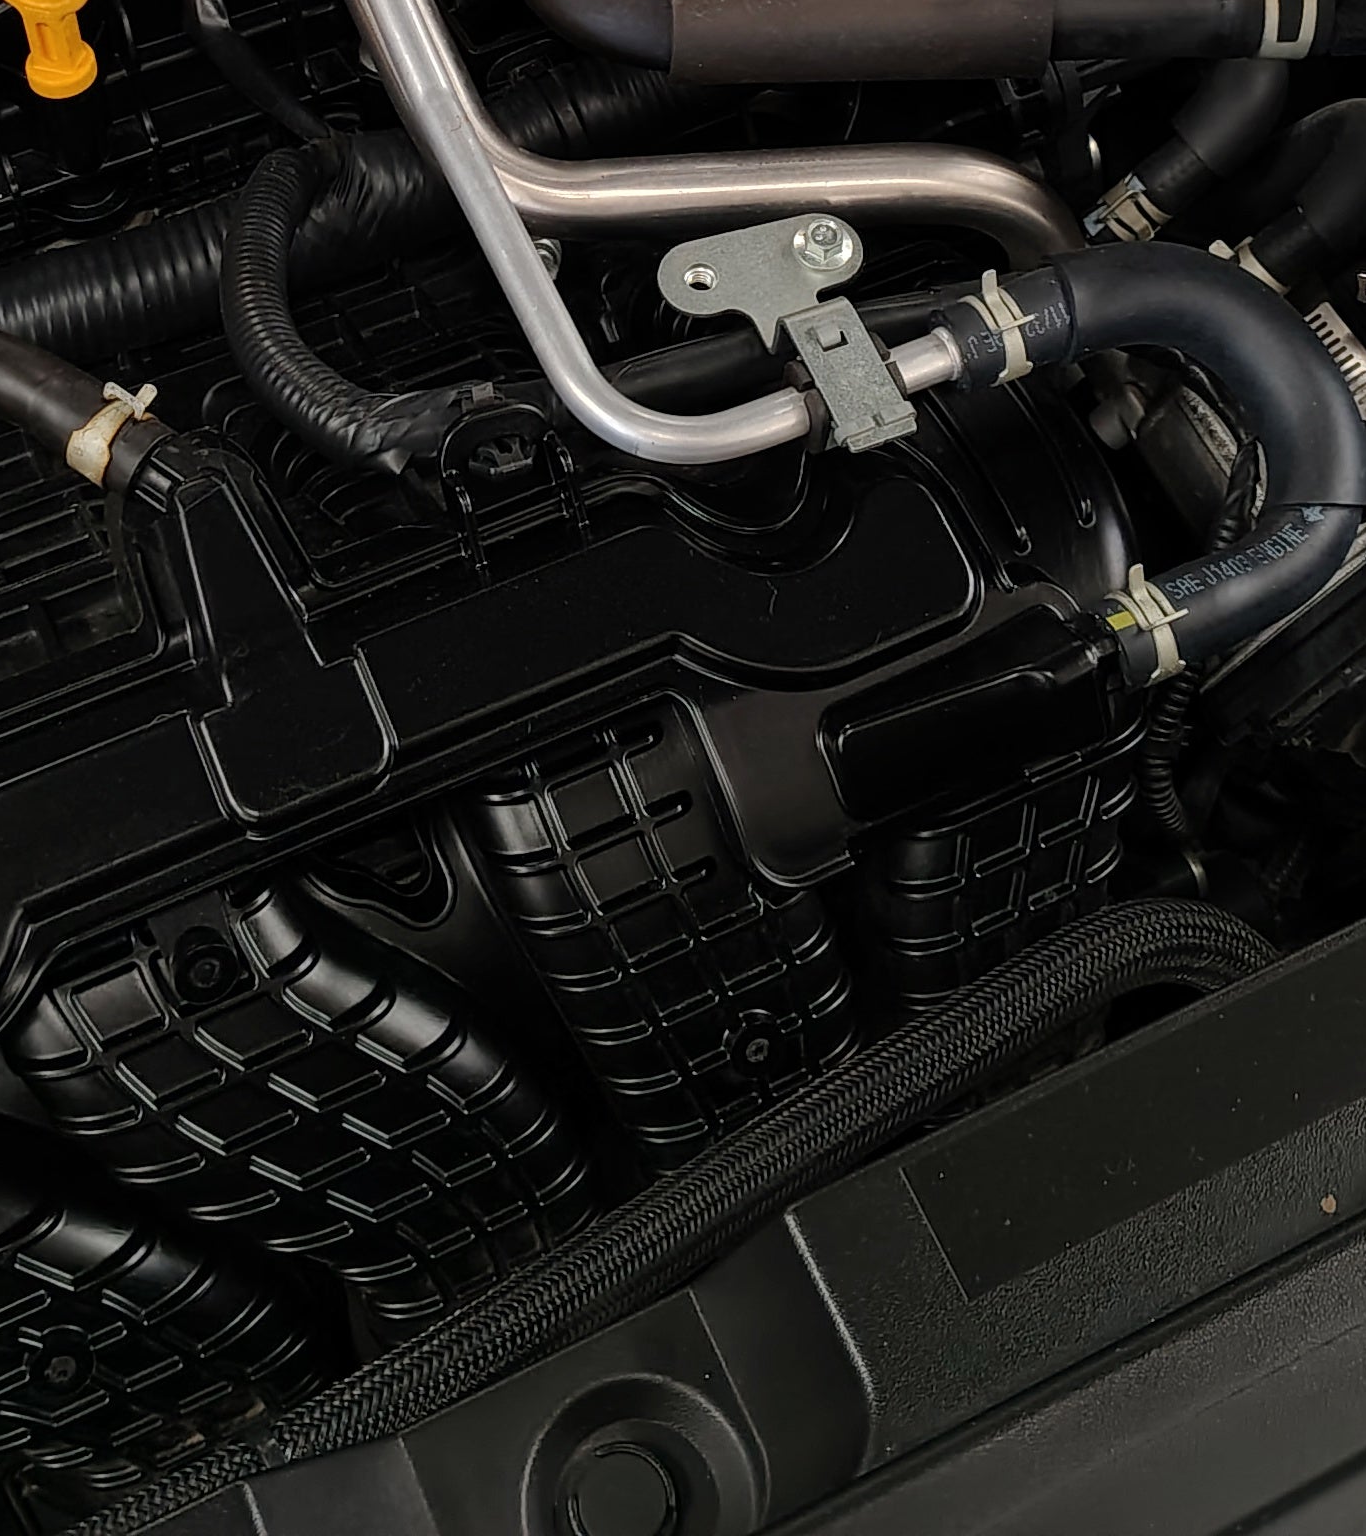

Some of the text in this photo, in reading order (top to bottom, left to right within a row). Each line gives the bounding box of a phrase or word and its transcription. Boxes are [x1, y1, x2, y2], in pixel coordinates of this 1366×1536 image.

[1165, 523, 1310, 600] SAE J1403 ENGINE
